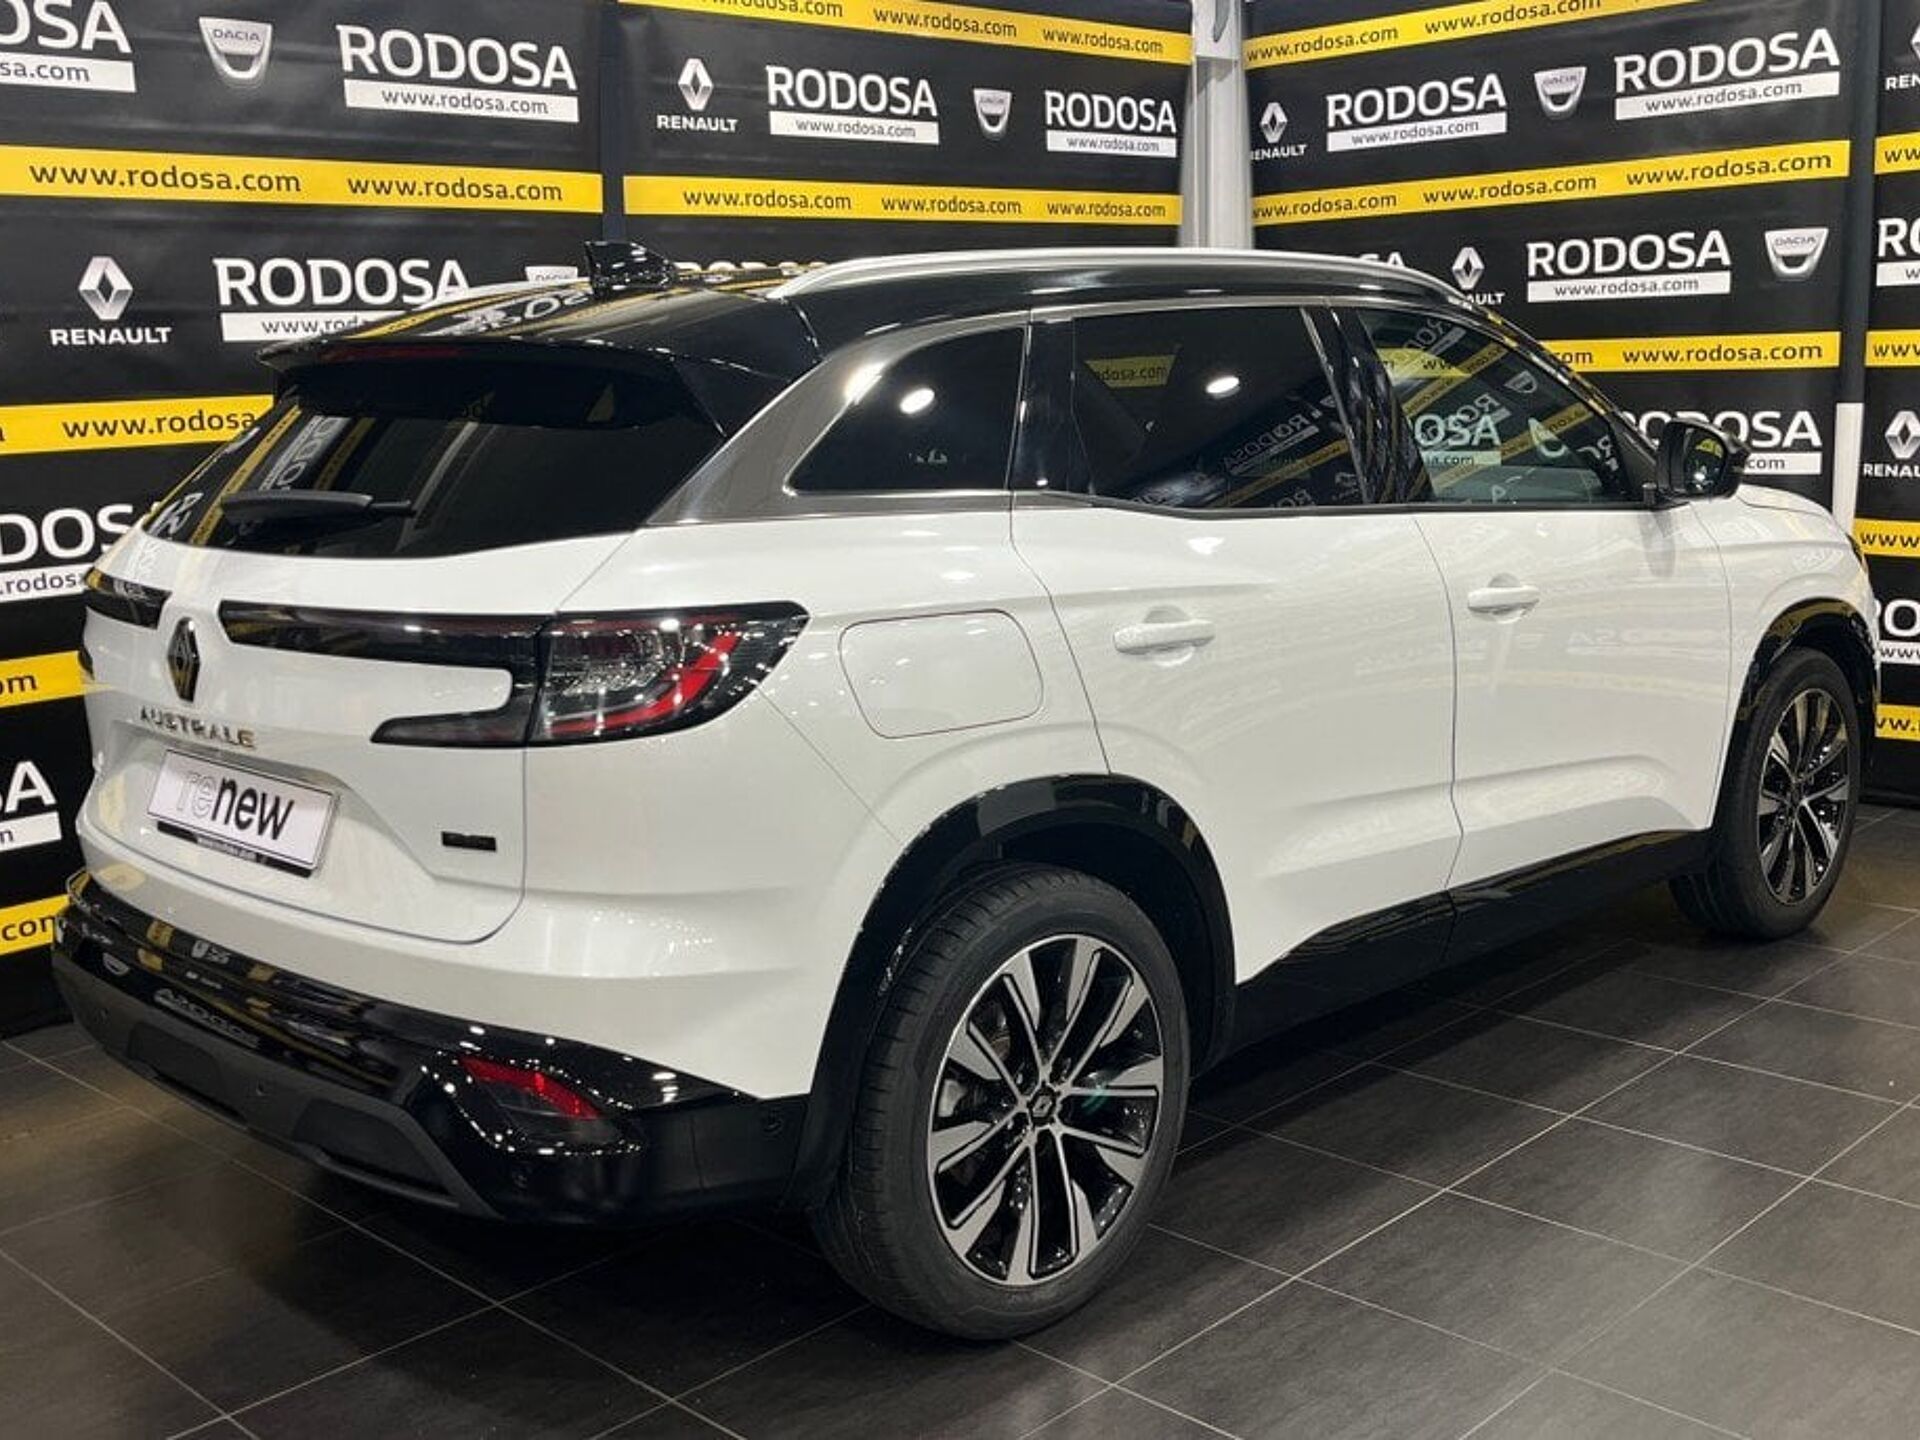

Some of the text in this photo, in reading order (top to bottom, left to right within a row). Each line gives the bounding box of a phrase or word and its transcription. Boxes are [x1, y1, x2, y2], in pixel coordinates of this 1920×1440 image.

[213, 28, 261, 42] DACIA
[873, 6, 1017, 37] www.rodosa.com
[1043, 27, 1163, 54] www.rodosa.com
[335, 24, 578, 90] RODOSA
[1614, 28, 1841, 93] RODOSA
[382, 89, 549, 114] www.rodosa.com
[766, 65, 938, 117] RODOSA
[1326, 73, 1507, 127] RODOSA
[1645, 81, 1803, 113] www.rodosa.com
[656, 114, 738, 133] RENAULT
[1045, 90, 1177, 133] RODOSA
[795, 118, 917, 139] www.rodosa.com
[1066, 135, 1160, 152] www.rodosa.com
[1351, 120, 1479, 146] www.rodosa.com
[1251, 144, 1307, 160] ENAULT
[29, 164, 563, 201] www.rodosa.com www.rodosa.com
[1423, 174, 1598, 204] www.rodosa.com
[1626, 152, 1832, 186] www.rodosa.com
[683, 189, 1166, 217] www.rodosa.com www.rodosa.com www.rodosa.com
[1526, 230, 1732, 277] RODOSA
[212, 257, 470, 306] RODOSA
[1554, 277, 1699, 297] www.rodosa.com
[50, 327, 173, 346] RENAULT
[1622, 345, 1823, 363] www.rodosa.com
[140, 706, 256, 750] AUSTRALE
